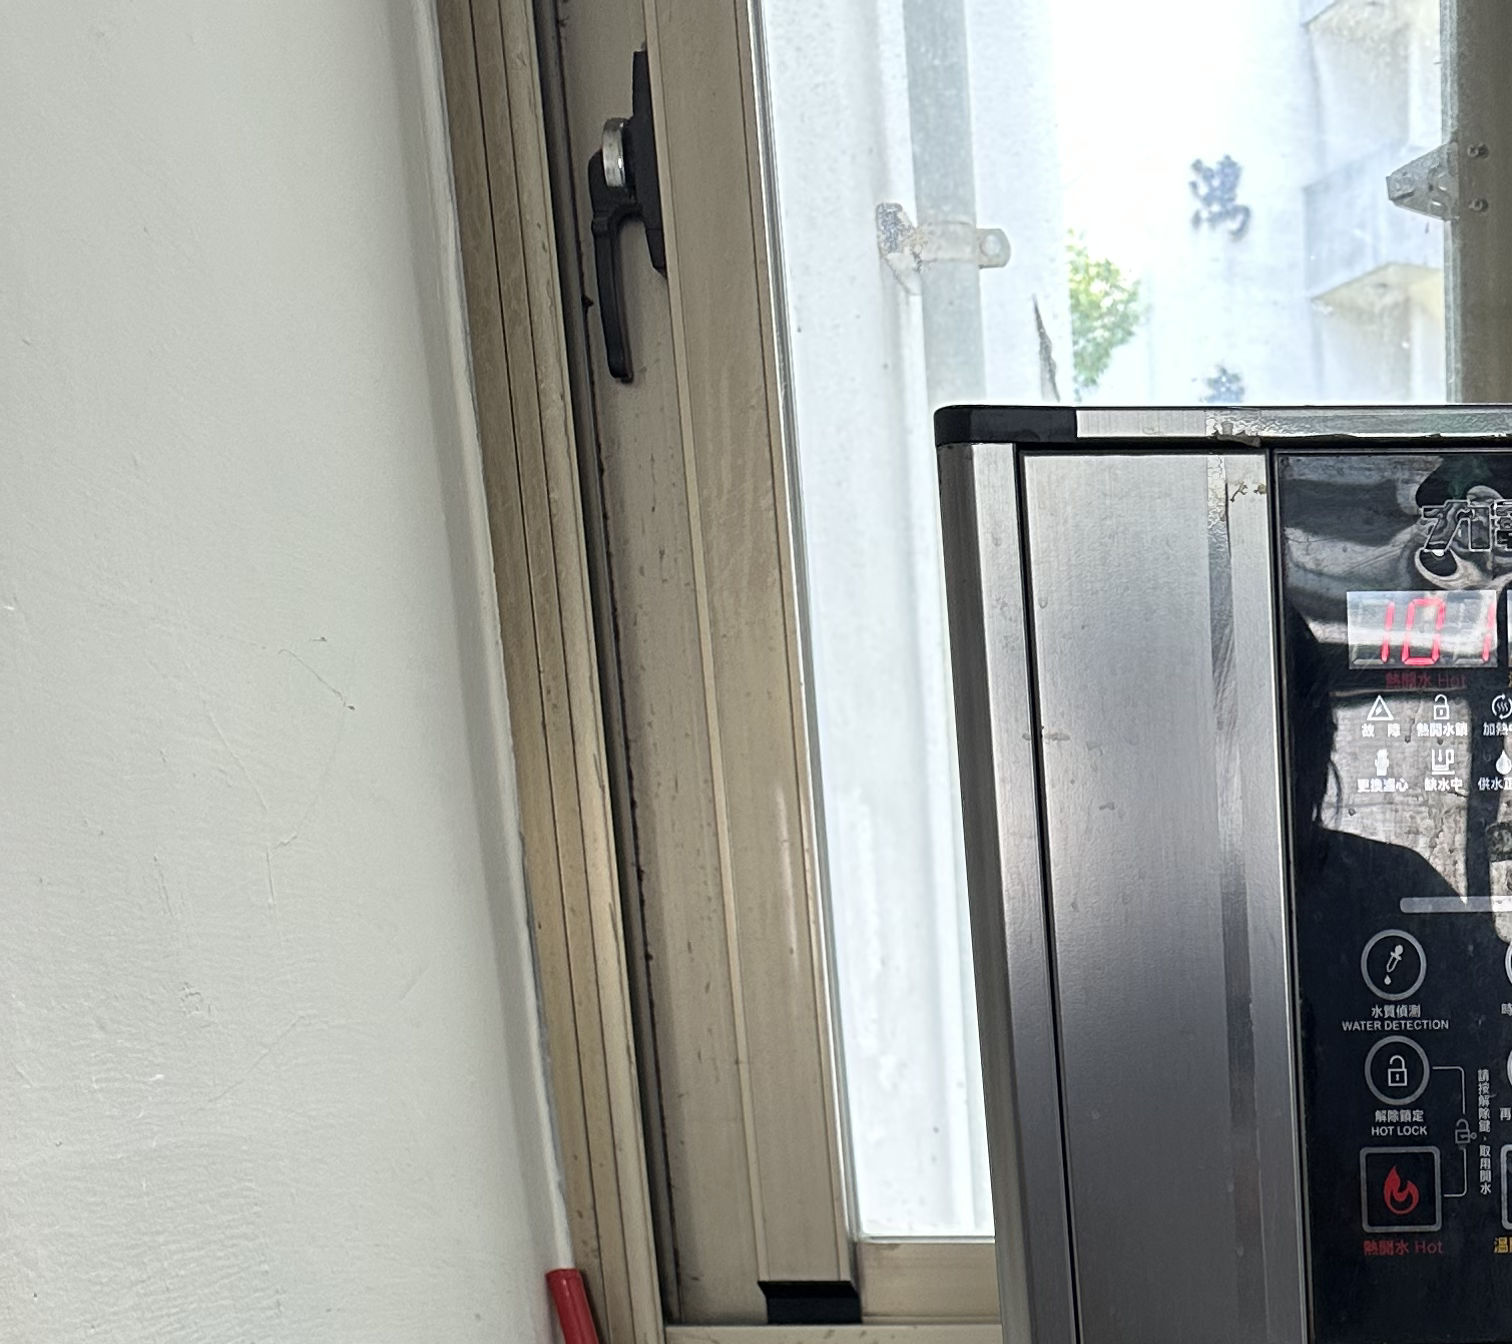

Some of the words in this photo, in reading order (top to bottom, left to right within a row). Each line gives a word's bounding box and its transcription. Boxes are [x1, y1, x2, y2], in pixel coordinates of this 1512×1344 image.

[1437, 671, 1467, 687] Hot
[1424, 777, 1463, 792] 缺水中
[1371, 1004, 1421, 1018] 水質偵測
[1342, 1020, 1382, 1031] WATER
[1384, 1019, 1449, 1031] DETECTION
[1375, 1109, 1424, 1123] 解除鎖定
[1371, 1126, 1395, 1136] HOT
[1397, 1125, 1428, 1136] LOCK
[1363, 1239, 1410, 1256] 熱開水
[1415, 1240, 1443, 1254] Hot
